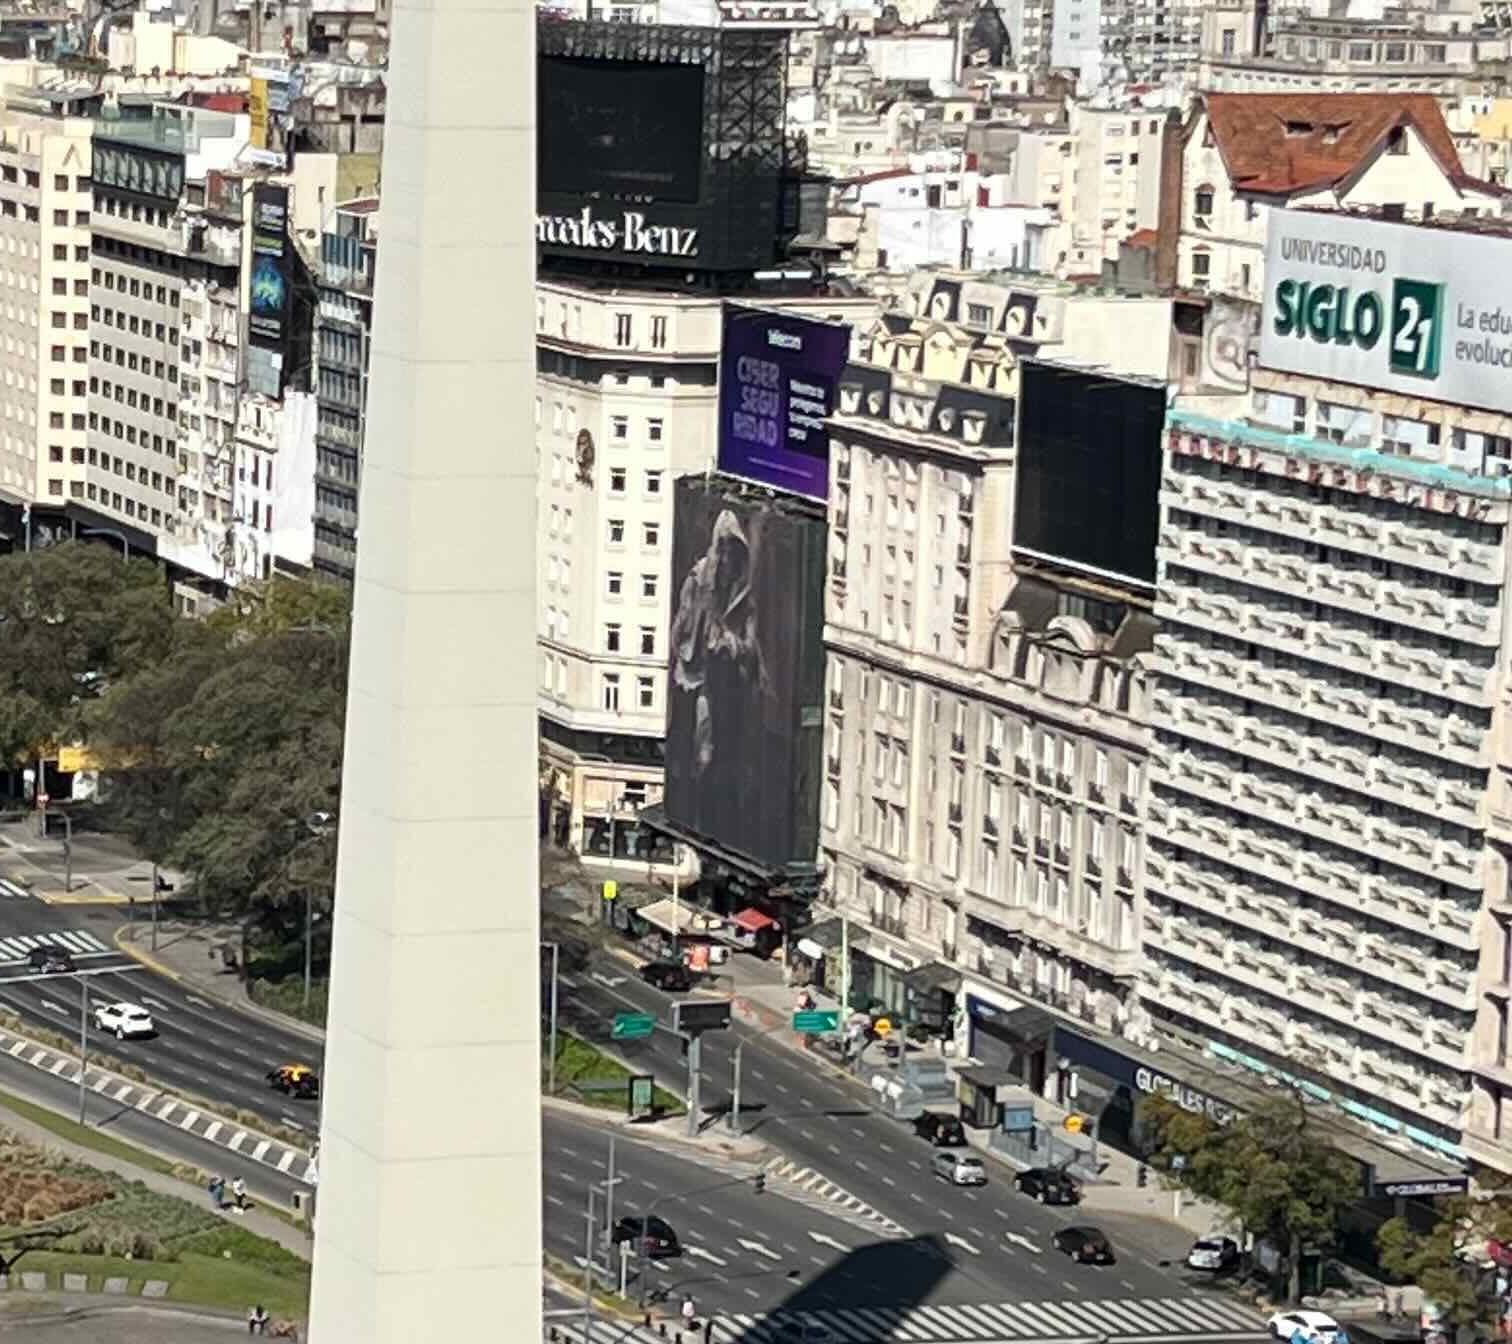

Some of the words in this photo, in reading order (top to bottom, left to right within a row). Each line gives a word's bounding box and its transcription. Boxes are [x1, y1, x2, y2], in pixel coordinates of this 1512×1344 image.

[536, 206, 698, 257] rcedes-Benz
[1281, 237, 1386, 274] UNIVERSIDAD
[1273, 278, 1384, 351] SIGLO
[1393, 296, 1434, 371] 21
[1457, 302, 1474, 329] La
[1479, 306, 1512, 335] edu
[1455, 338, 1512, 369] evoluc
